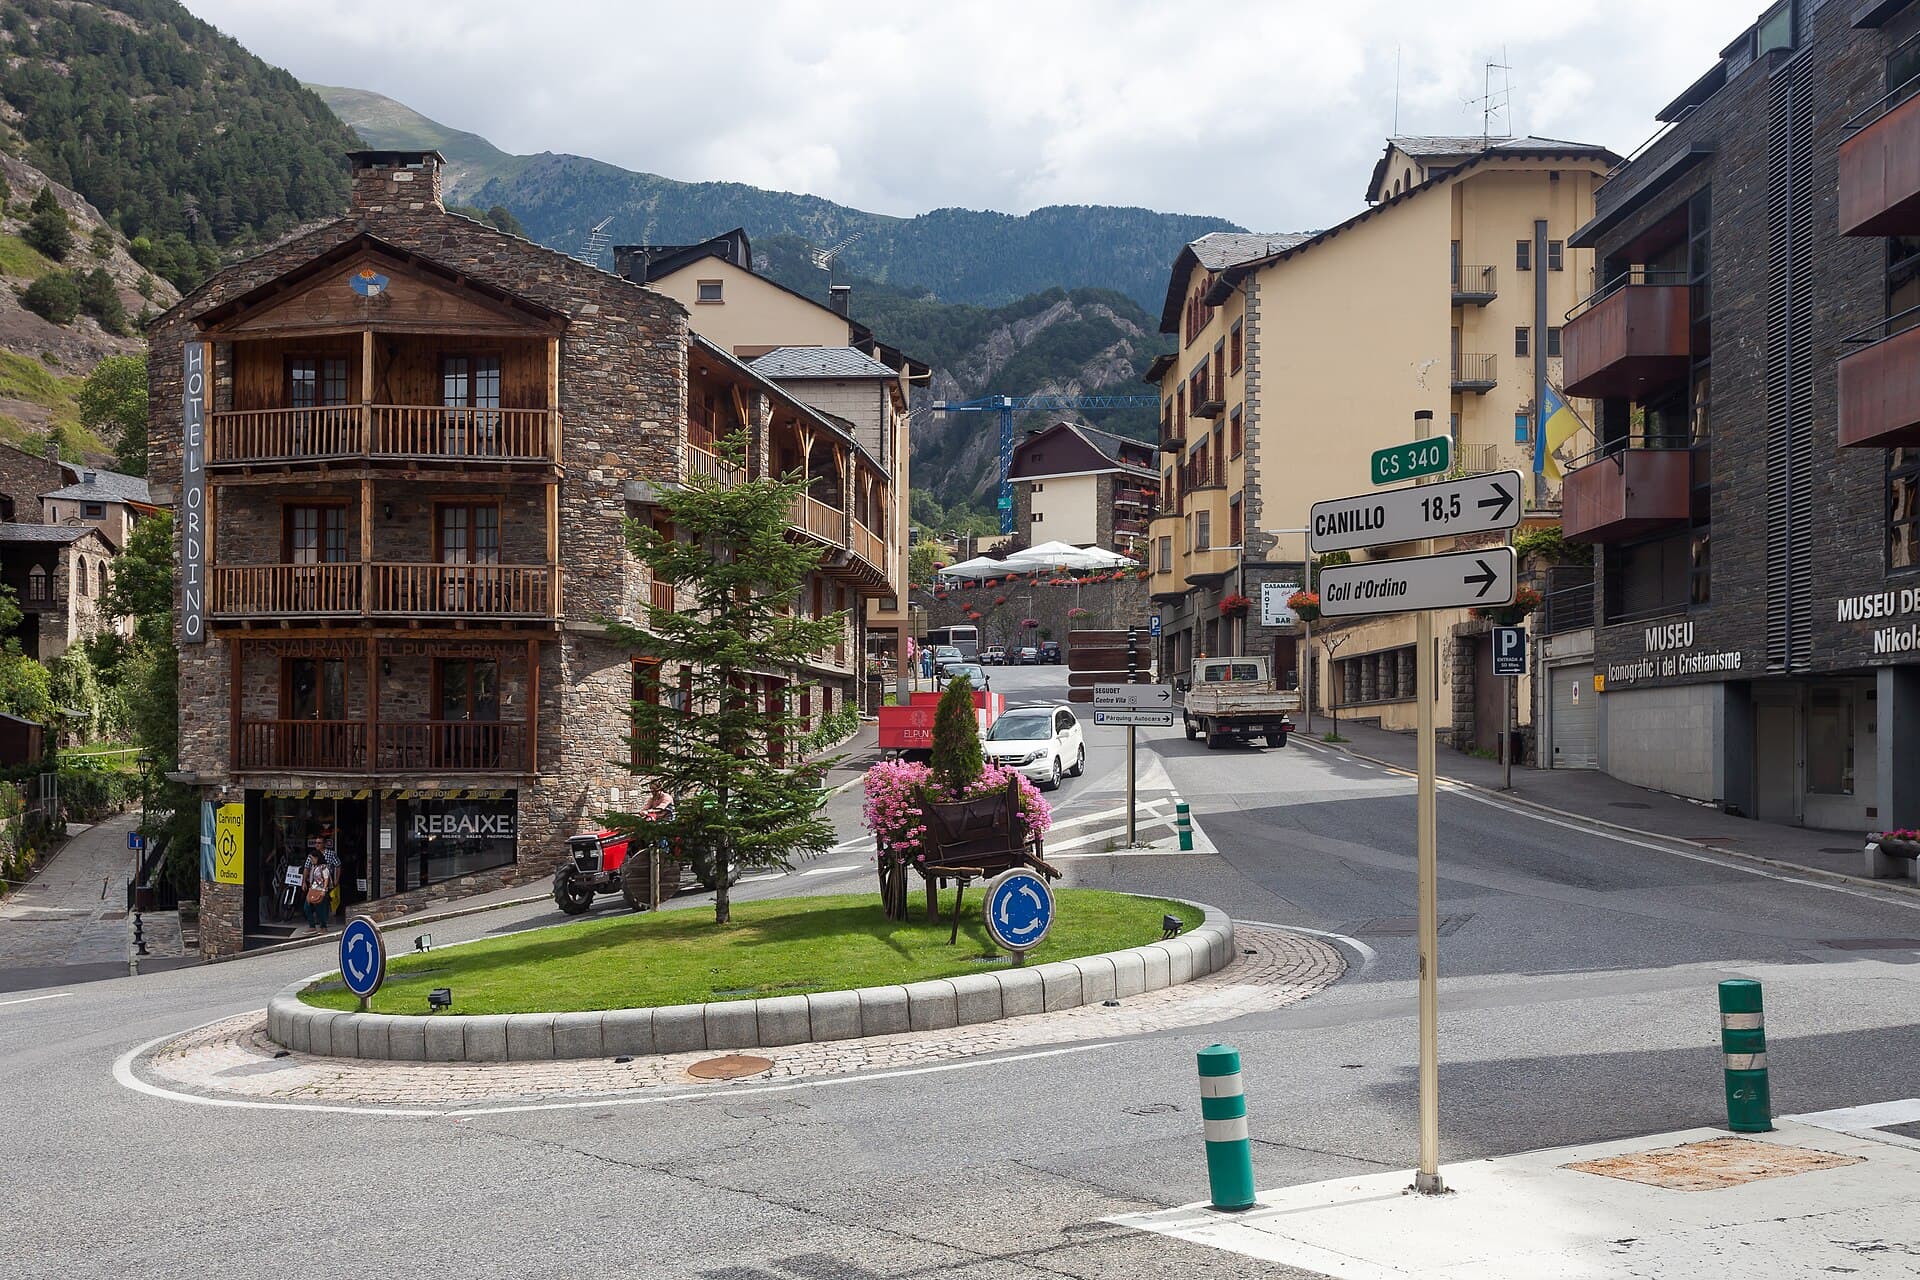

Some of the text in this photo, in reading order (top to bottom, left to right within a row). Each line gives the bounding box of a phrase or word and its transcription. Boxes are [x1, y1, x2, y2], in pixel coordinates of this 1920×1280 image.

[1380, 446, 1440, 476] CS 340
[186, 348, 202, 636] HOTEL ORDINO
[1315, 493, 1461, 537] CANILLO 18,5
[1327, 577, 1407, 602] Coll d'Ordino
[1837, 588, 1920, 622] MUSEU DE
[1151, 617, 1159, 630] P
[1502, 630, 1518, 656] P
[1645, 621, 1694, 652] MUSEU
[1608, 649, 1741, 683] Iconogràfic i del Cristianisme
[1095, 696, 1114, 704] Centre
[1134, 713, 1161, 722] Autocars
[407, 790, 451, 798] LOCATION
[219, 813, 244, 827] Carving!
[220, 869, 238, 879] Ordino
